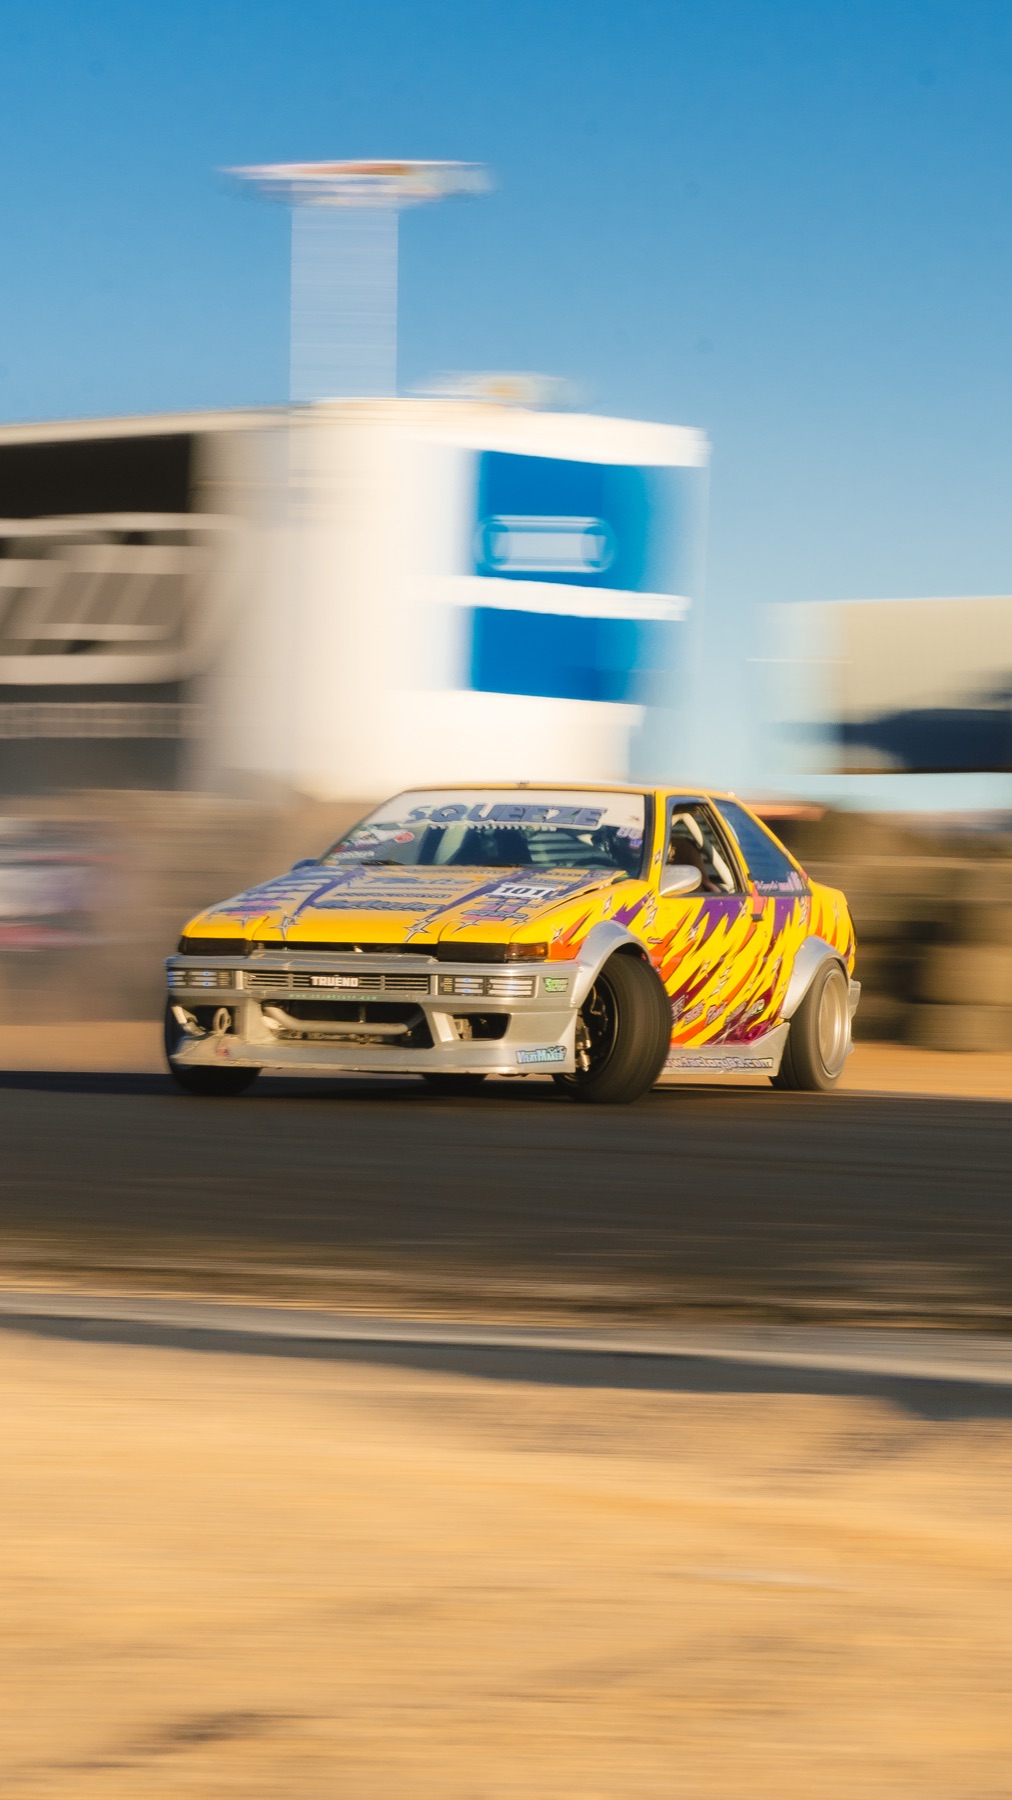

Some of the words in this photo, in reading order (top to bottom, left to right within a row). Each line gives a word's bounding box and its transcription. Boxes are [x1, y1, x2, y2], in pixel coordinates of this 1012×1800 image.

[405, 804, 606, 827] SQUEEZE
[500, 886, 547, 896] 101
[311, 976, 359, 987] TRUENO
